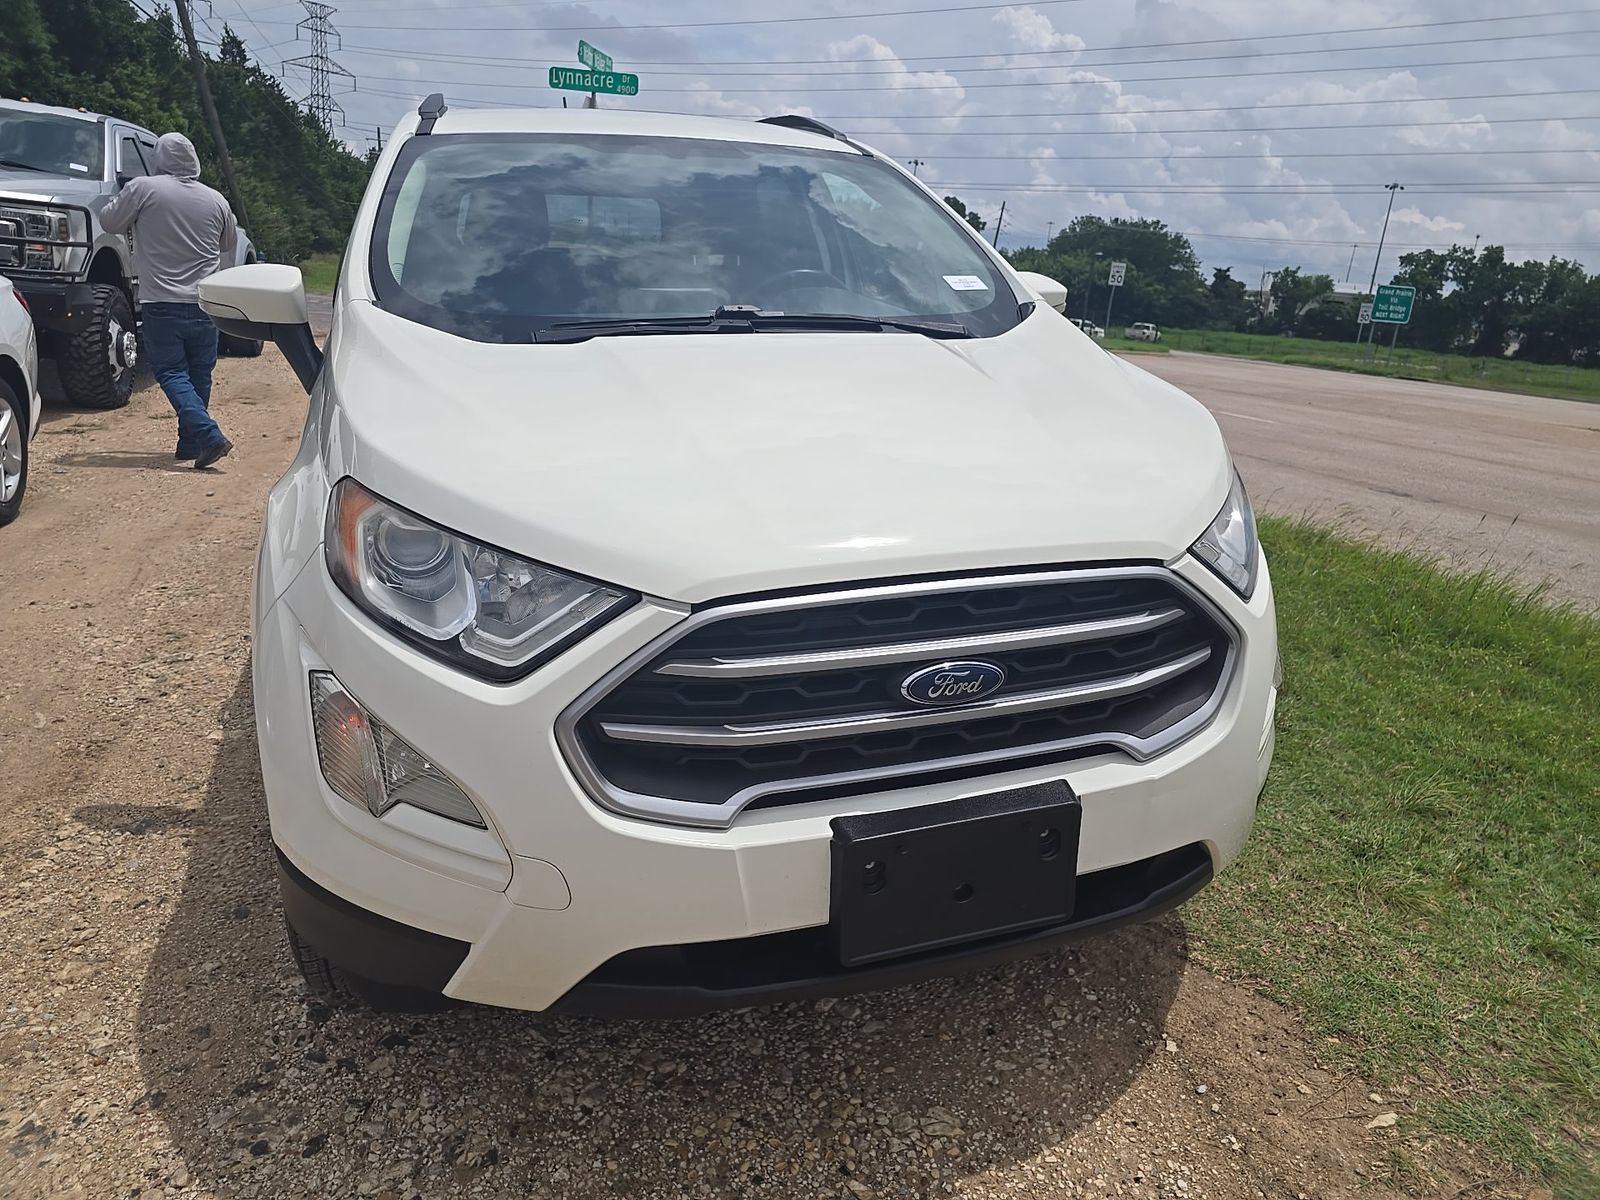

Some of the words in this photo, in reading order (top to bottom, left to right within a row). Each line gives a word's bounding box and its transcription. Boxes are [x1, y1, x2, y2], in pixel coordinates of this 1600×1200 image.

[552, 68, 614, 88] Lynnacre
[622, 75, 630, 83] Dr
[616, 85, 636, 94] 4900
[1110, 274, 1123, 284] 50
[928, 670, 984, 698] Ford
